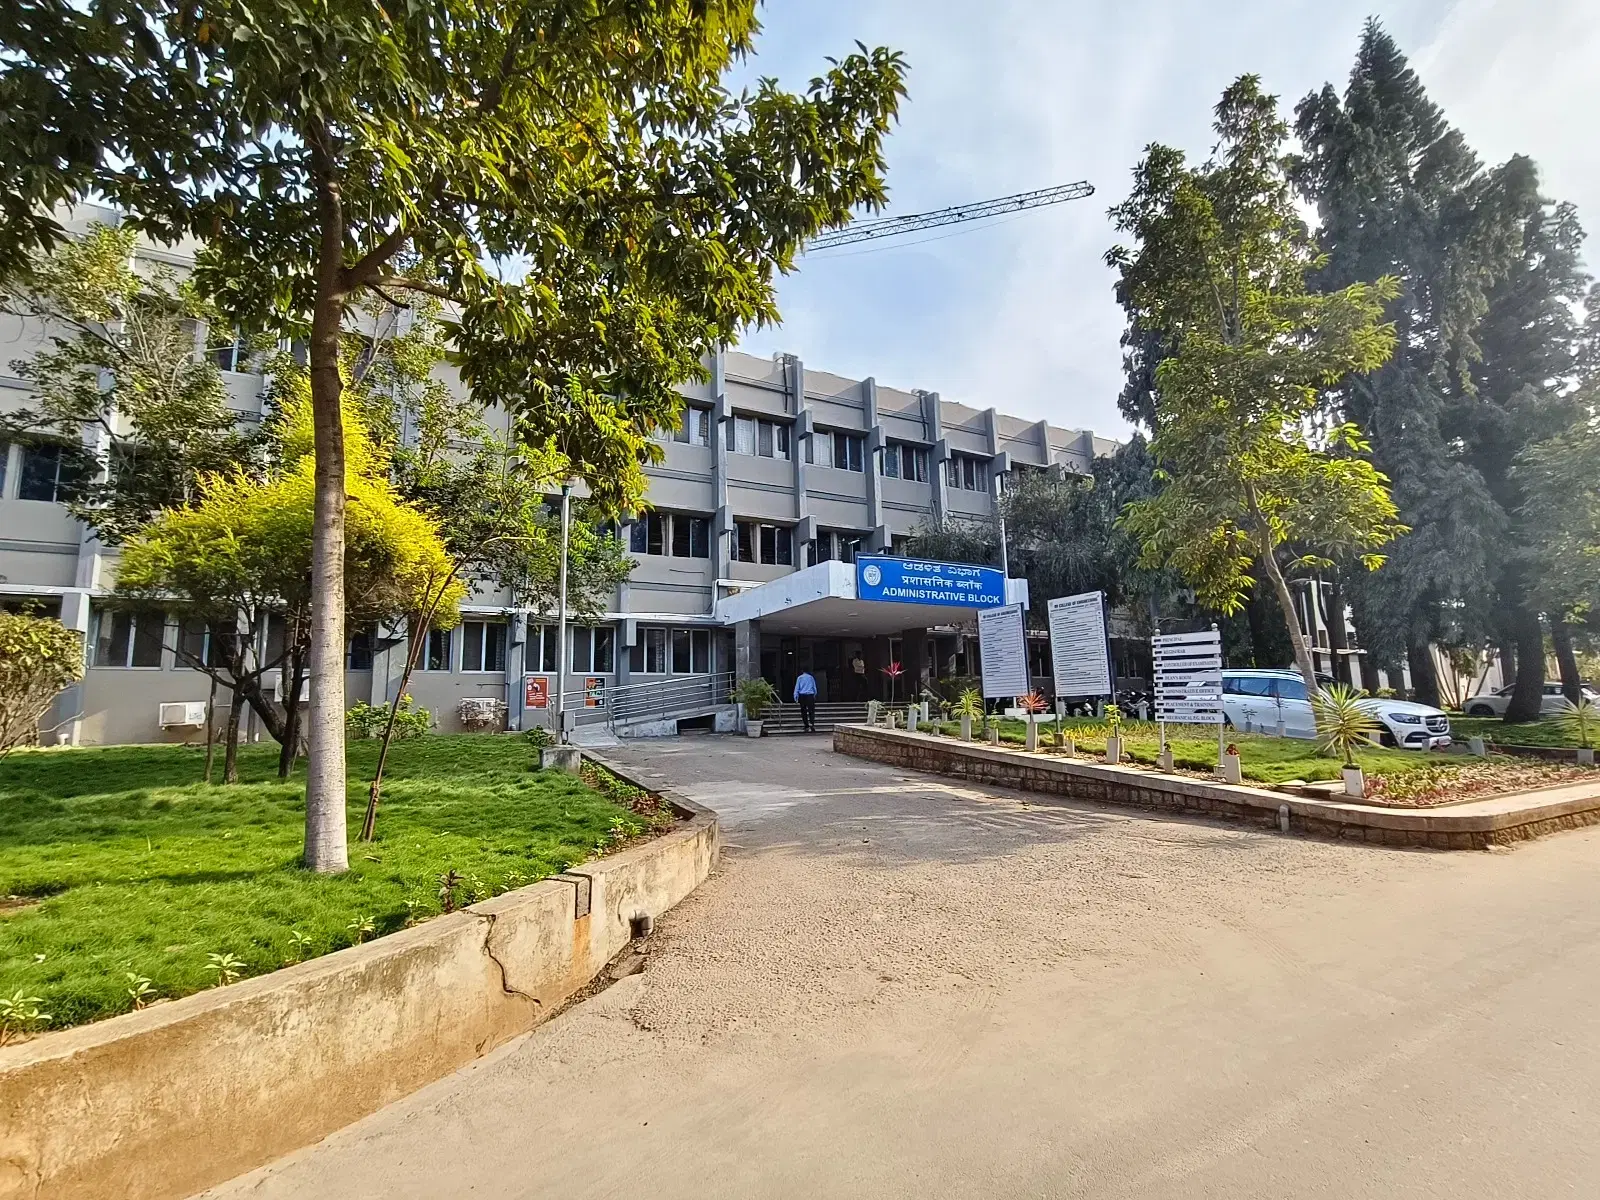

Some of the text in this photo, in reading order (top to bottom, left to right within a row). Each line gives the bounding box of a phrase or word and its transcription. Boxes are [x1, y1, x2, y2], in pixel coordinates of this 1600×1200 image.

[948, 566, 981, 577] ವಿಭಾಗ
[901, 575, 983, 590] प्रशासनिक ब्लॉक
[882, 586, 1000, 604] ADMINISTRATIVE BLOCK
